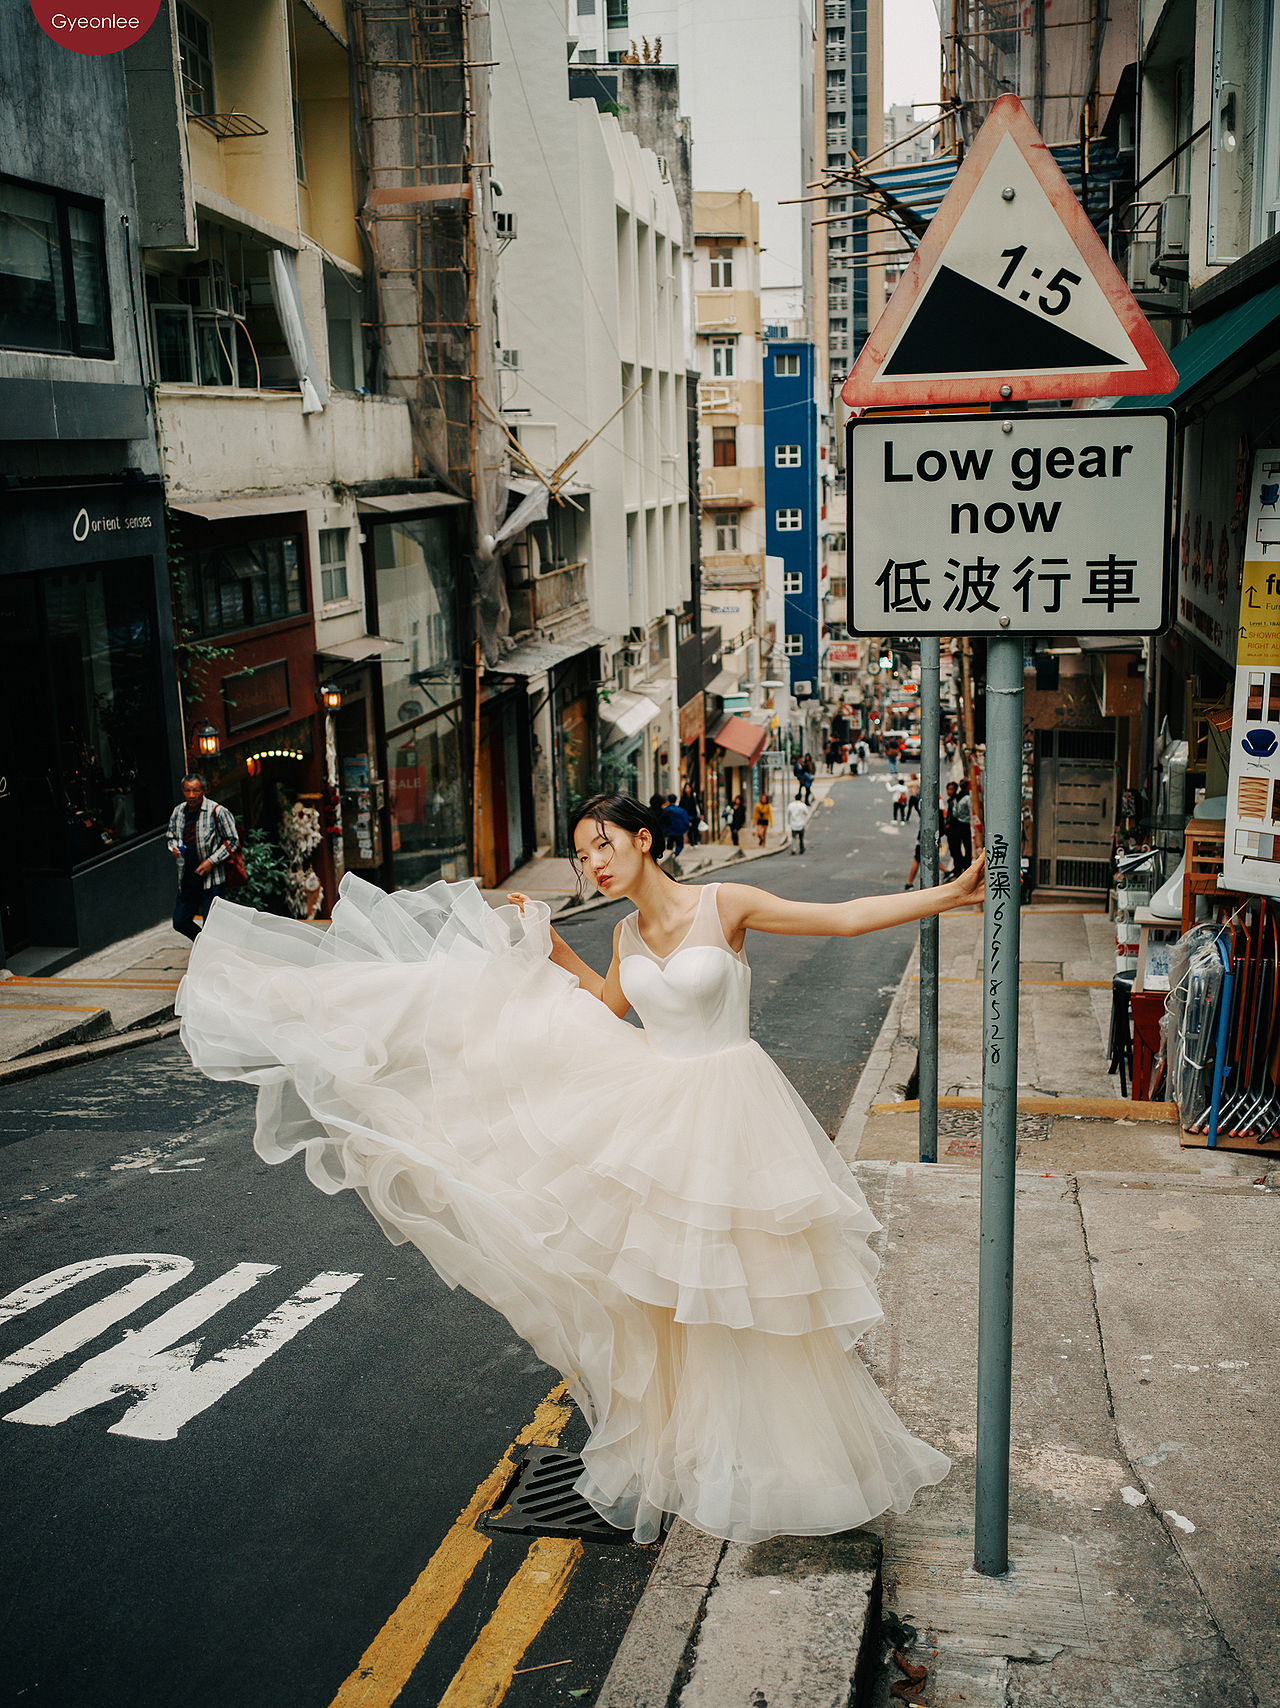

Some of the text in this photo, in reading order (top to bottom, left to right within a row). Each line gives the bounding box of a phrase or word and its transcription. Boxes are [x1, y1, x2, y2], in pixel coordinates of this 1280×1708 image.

[997, 244, 1082, 316] 1:5
[884, 441, 1134, 491] Low gear
[91, 516, 121, 532] orient
[124, 516, 152, 529] senses
[951, 501, 1062, 534] now
[875, 554, 1140, 613] 低波行車
[390, 777, 422, 791] SALE
